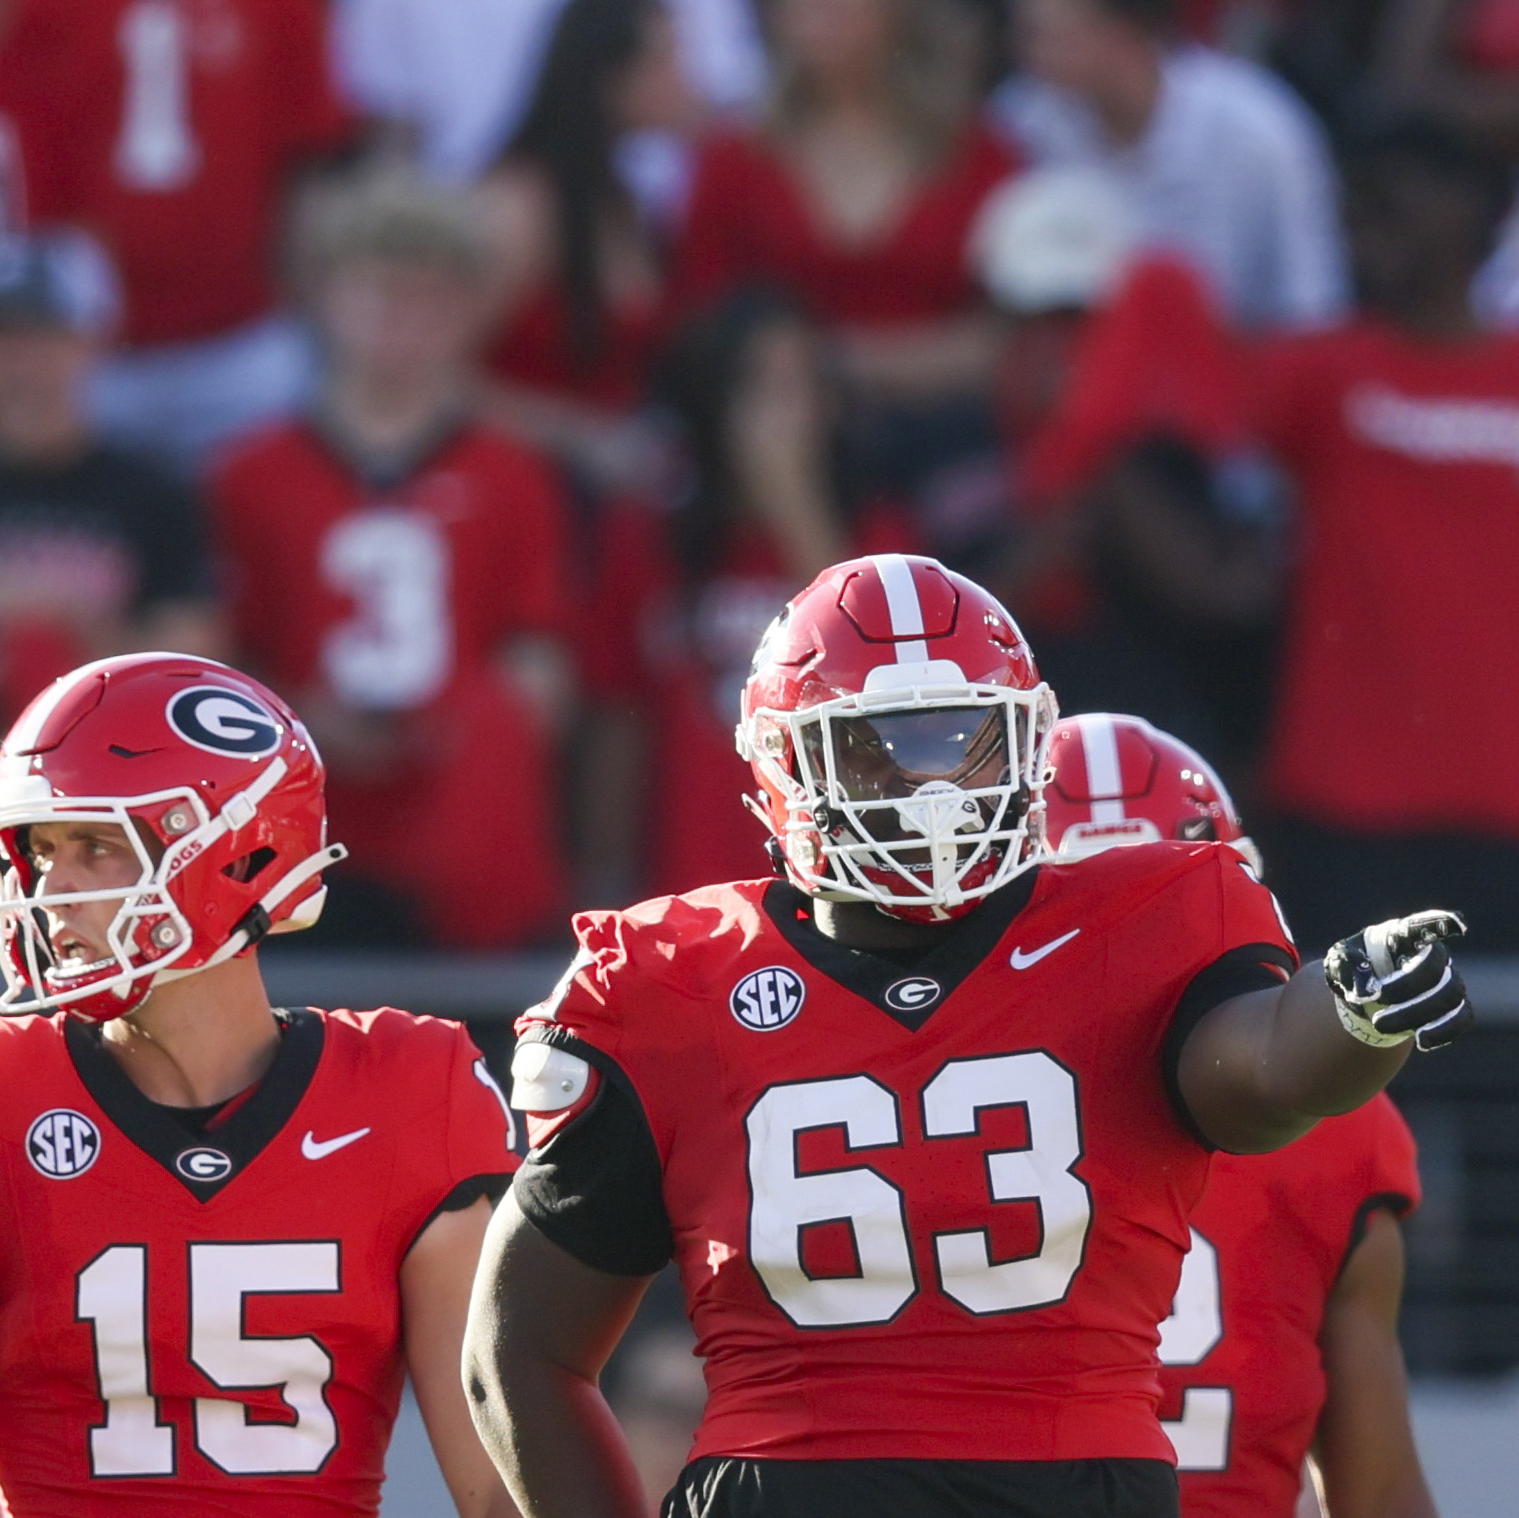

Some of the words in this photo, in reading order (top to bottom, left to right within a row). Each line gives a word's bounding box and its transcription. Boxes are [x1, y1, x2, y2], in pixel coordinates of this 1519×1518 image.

[112, 2, 204, 190] 1
[315, 506, 456, 708] 3
[166, 685, 281, 759] G
[736, 970, 799, 1027] SEC
[32, 1113, 94, 1175] SEC
[744, 1048, 1094, 1331] 63
[75, 1240, 343, 1478] 15
